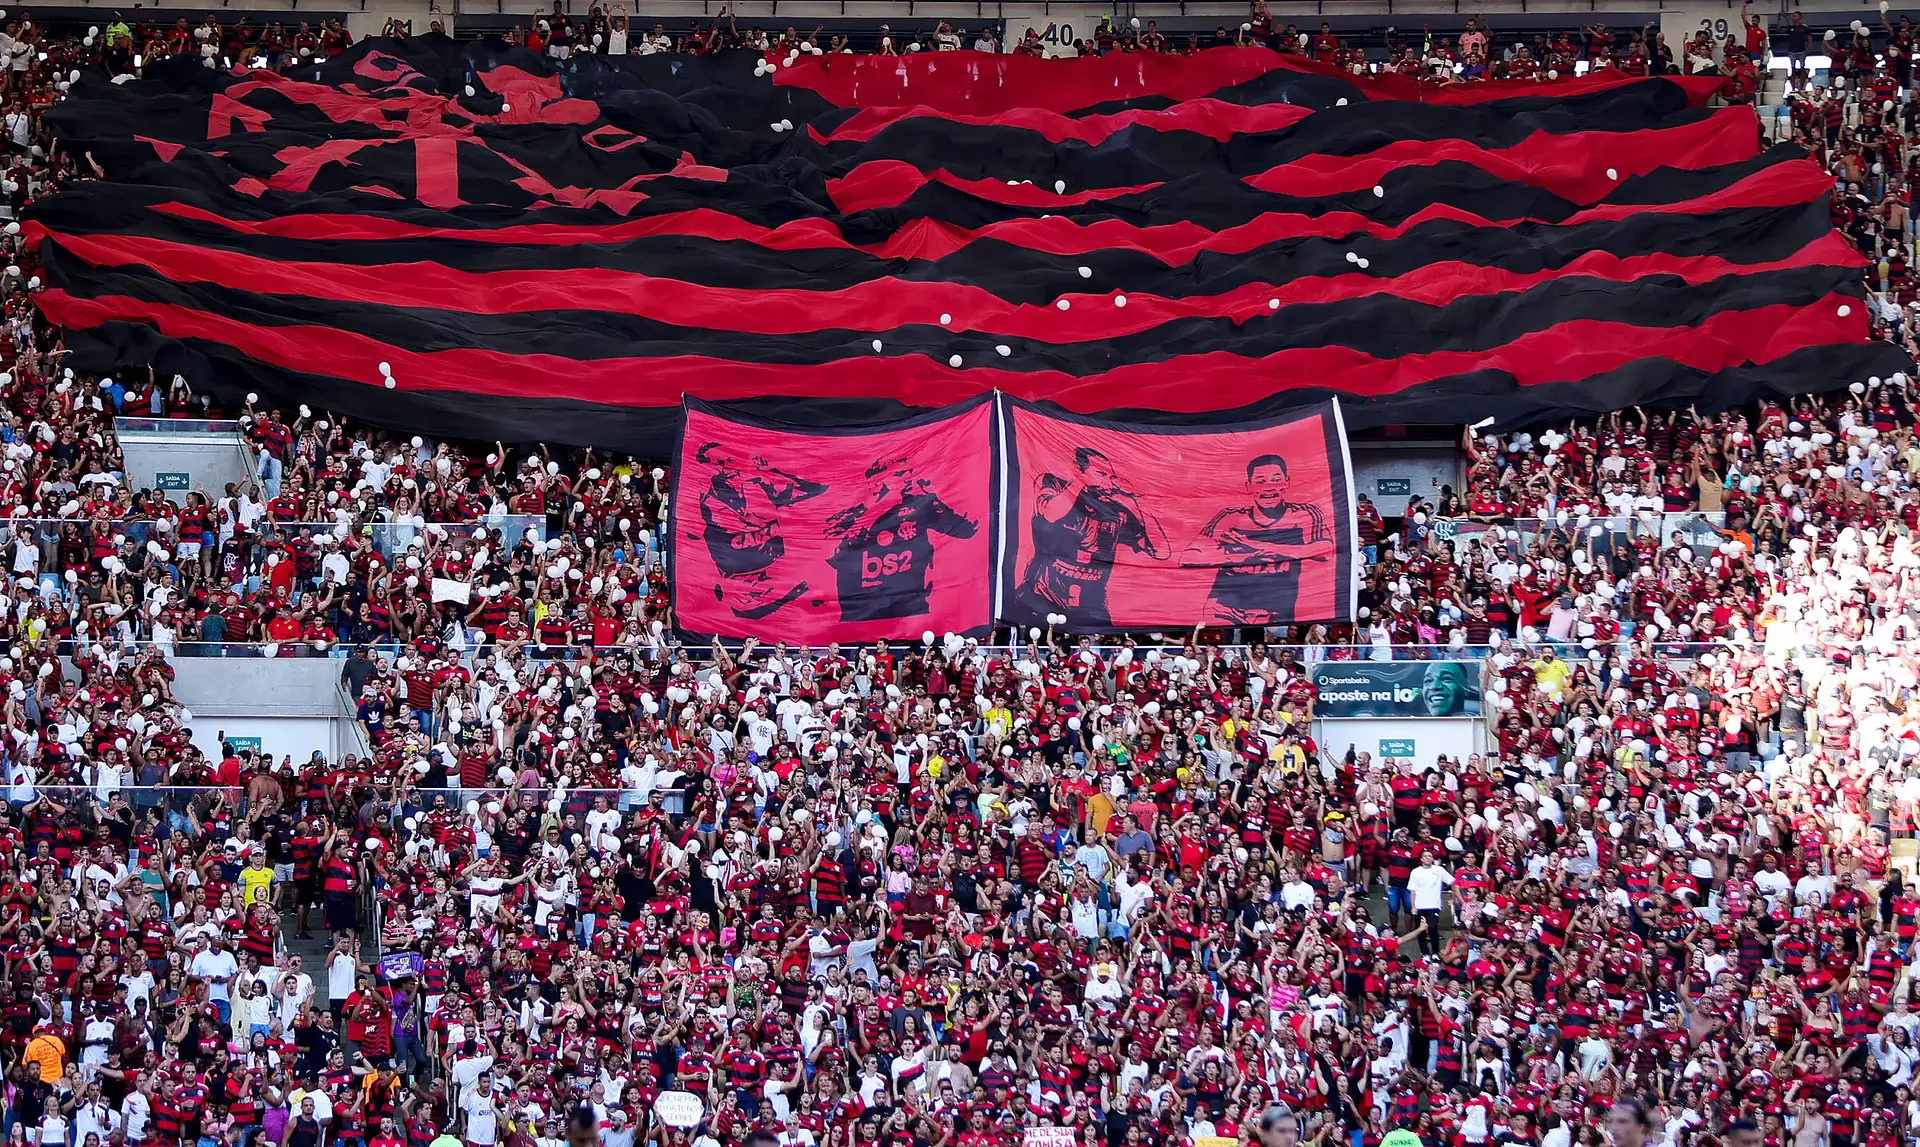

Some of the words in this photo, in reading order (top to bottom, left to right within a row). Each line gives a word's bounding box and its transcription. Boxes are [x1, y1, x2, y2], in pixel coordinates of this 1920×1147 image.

[1045, 23, 1074, 46] 40
[1700, 18, 1728, 41] 39
[862, 550, 913, 579] bs2
[1319, 690, 1370, 704] aposte
[1371, 691, 1391, 701] na
[373, 775, 388, 785] bs2
